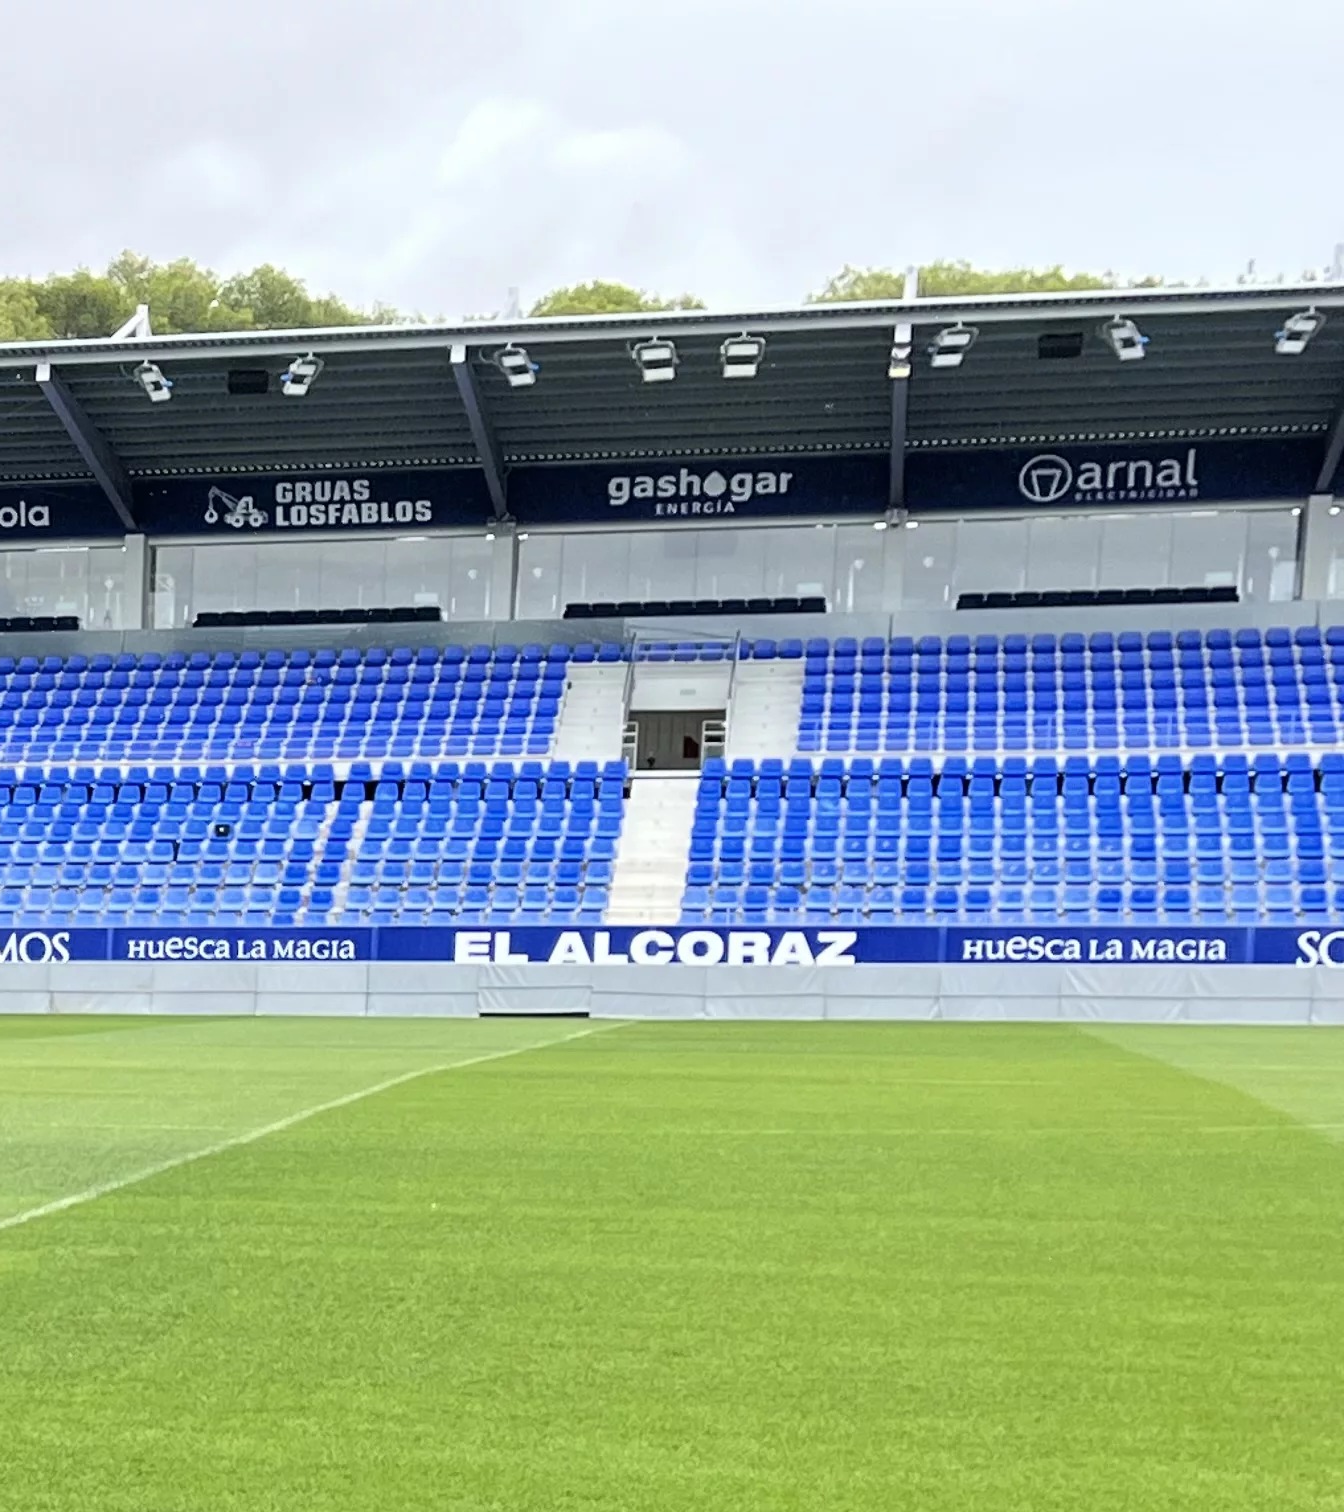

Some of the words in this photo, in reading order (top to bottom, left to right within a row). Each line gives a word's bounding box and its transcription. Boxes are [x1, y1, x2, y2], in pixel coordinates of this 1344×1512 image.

[1077, 448, 1199, 490] arnal
[275, 480, 370, 503] GRUAS
[275, 500, 432, 526] LOSFABLOS
[654, 500, 735, 516] ENERGÍA
[454, 931, 529, 964] EL
[548, 930, 858, 965] ALCORAZ
